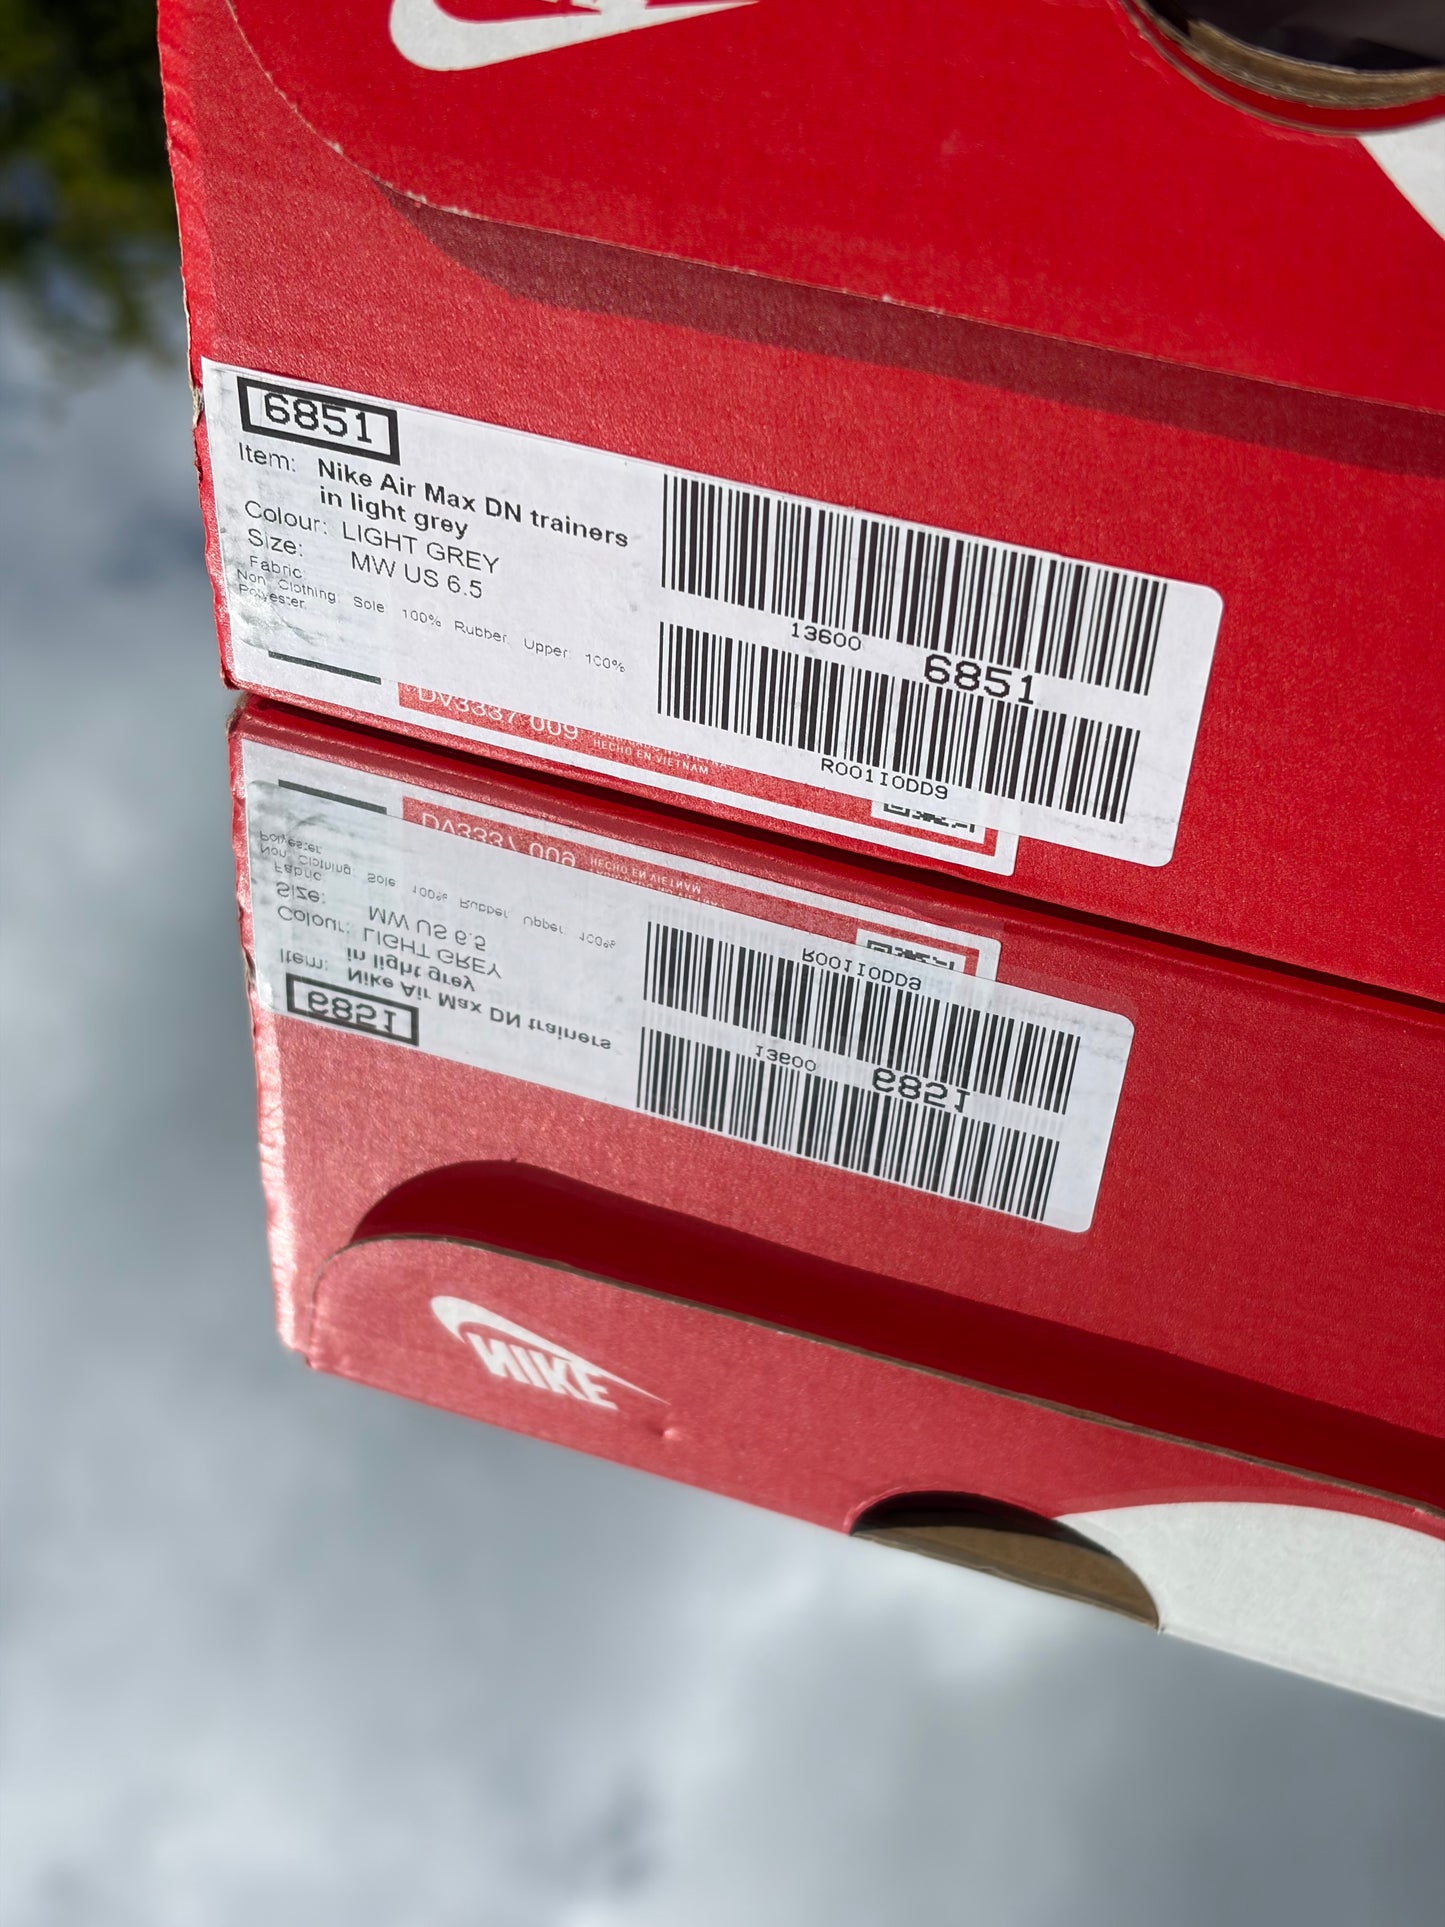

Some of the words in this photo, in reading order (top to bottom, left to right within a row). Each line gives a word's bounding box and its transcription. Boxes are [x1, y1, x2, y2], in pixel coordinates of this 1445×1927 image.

[264, 392, 372, 443] 6851
[239, 442, 295, 472] Item:
[318, 458, 372, 487] Nike
[380, 474, 416, 497] Air
[425, 483, 476, 512] Max
[485, 496, 521, 522] DN
[530, 510, 628, 548] trainers
[321, 486, 342, 508] in
[351, 492, 406, 522] light
[414, 512, 468, 540] grey
[245, 500, 327, 535] Colour:
[342, 521, 418, 554] LIGHT
[427, 542, 499, 574] GREY
[248, 528, 303, 557] Size:
[351, 551, 396, 578] MW
[404, 563, 439, 588] US
[447, 575, 482, 599] 6.5
[402, 609, 441, 627] 100%
[585, 653, 626, 673] 100%
[791, 622, 862, 651] 13600
[924, 653, 1035, 705] 6851
[593, 739, 632, 756] HECHO
[637, 751, 652, 761] EN
[656, 754, 710, 775] VIETNAM
